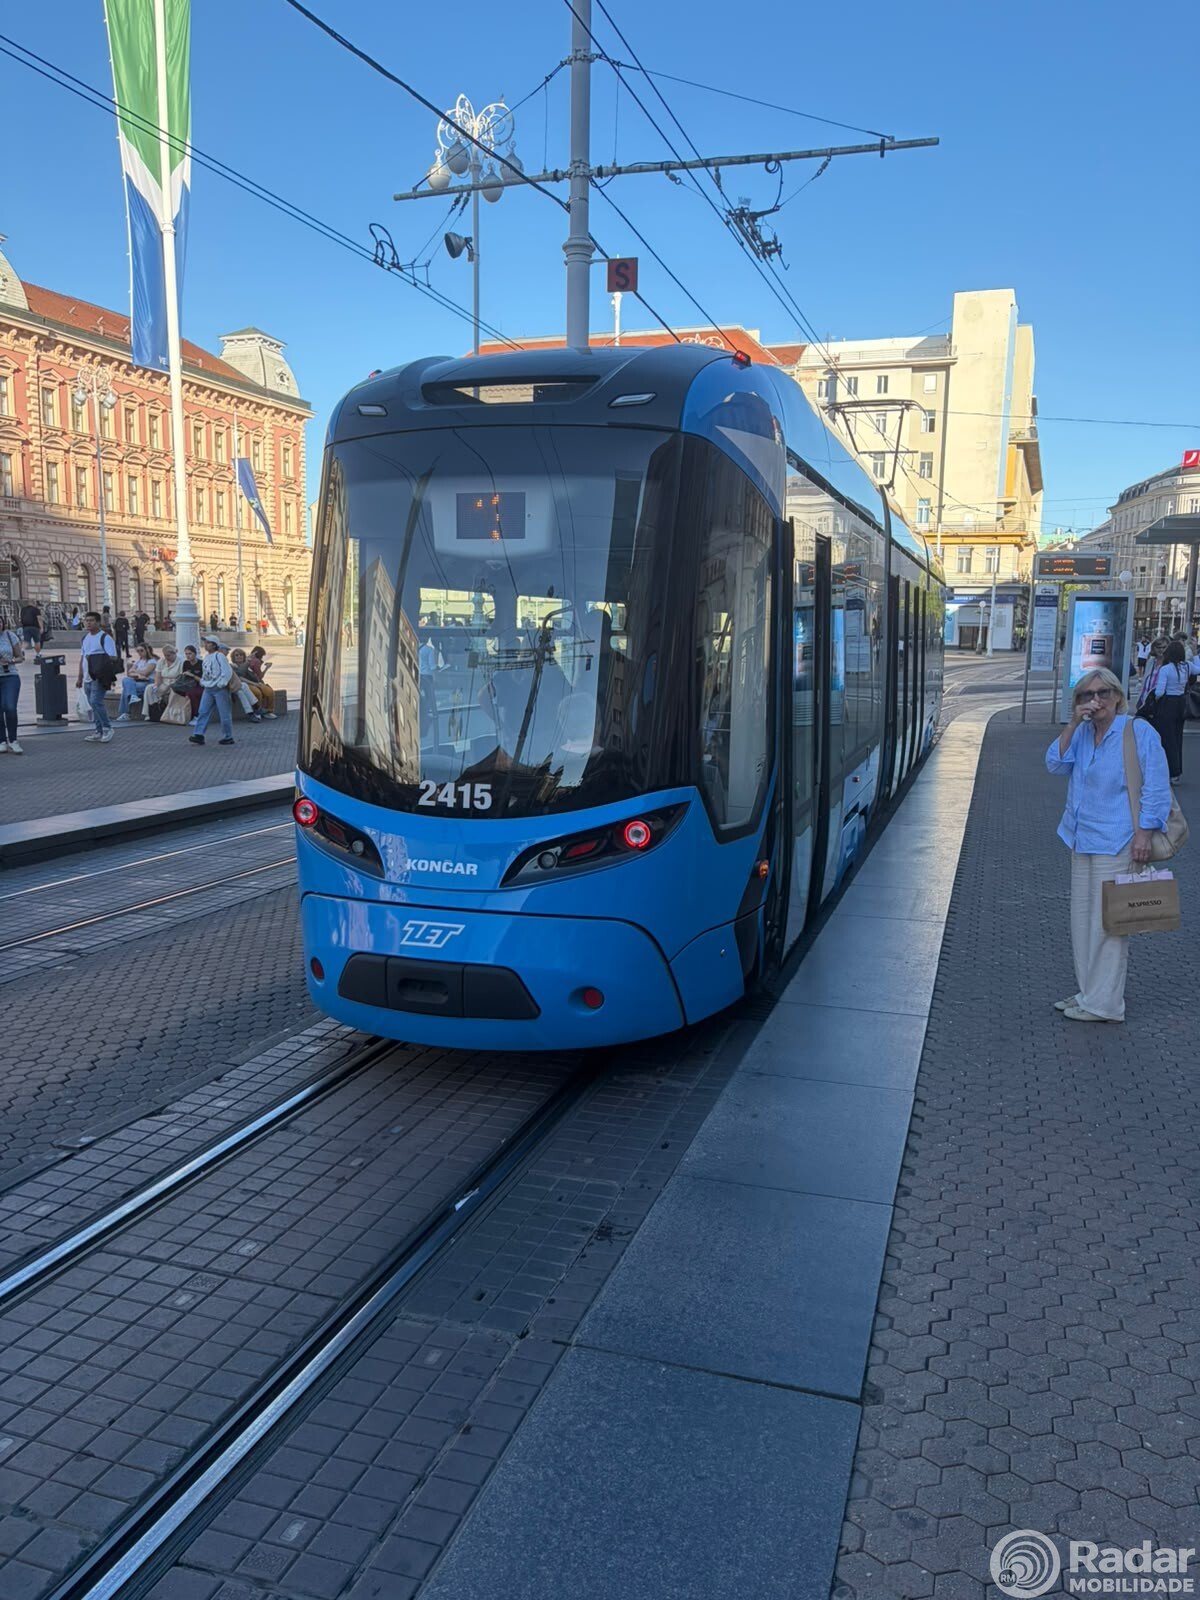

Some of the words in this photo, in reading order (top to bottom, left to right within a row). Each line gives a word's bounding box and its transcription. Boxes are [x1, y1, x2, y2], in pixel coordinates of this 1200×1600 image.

[615, 262, 630, 290] S
[418, 780, 492, 810] 2415
[400, 920, 466, 948] ZET
